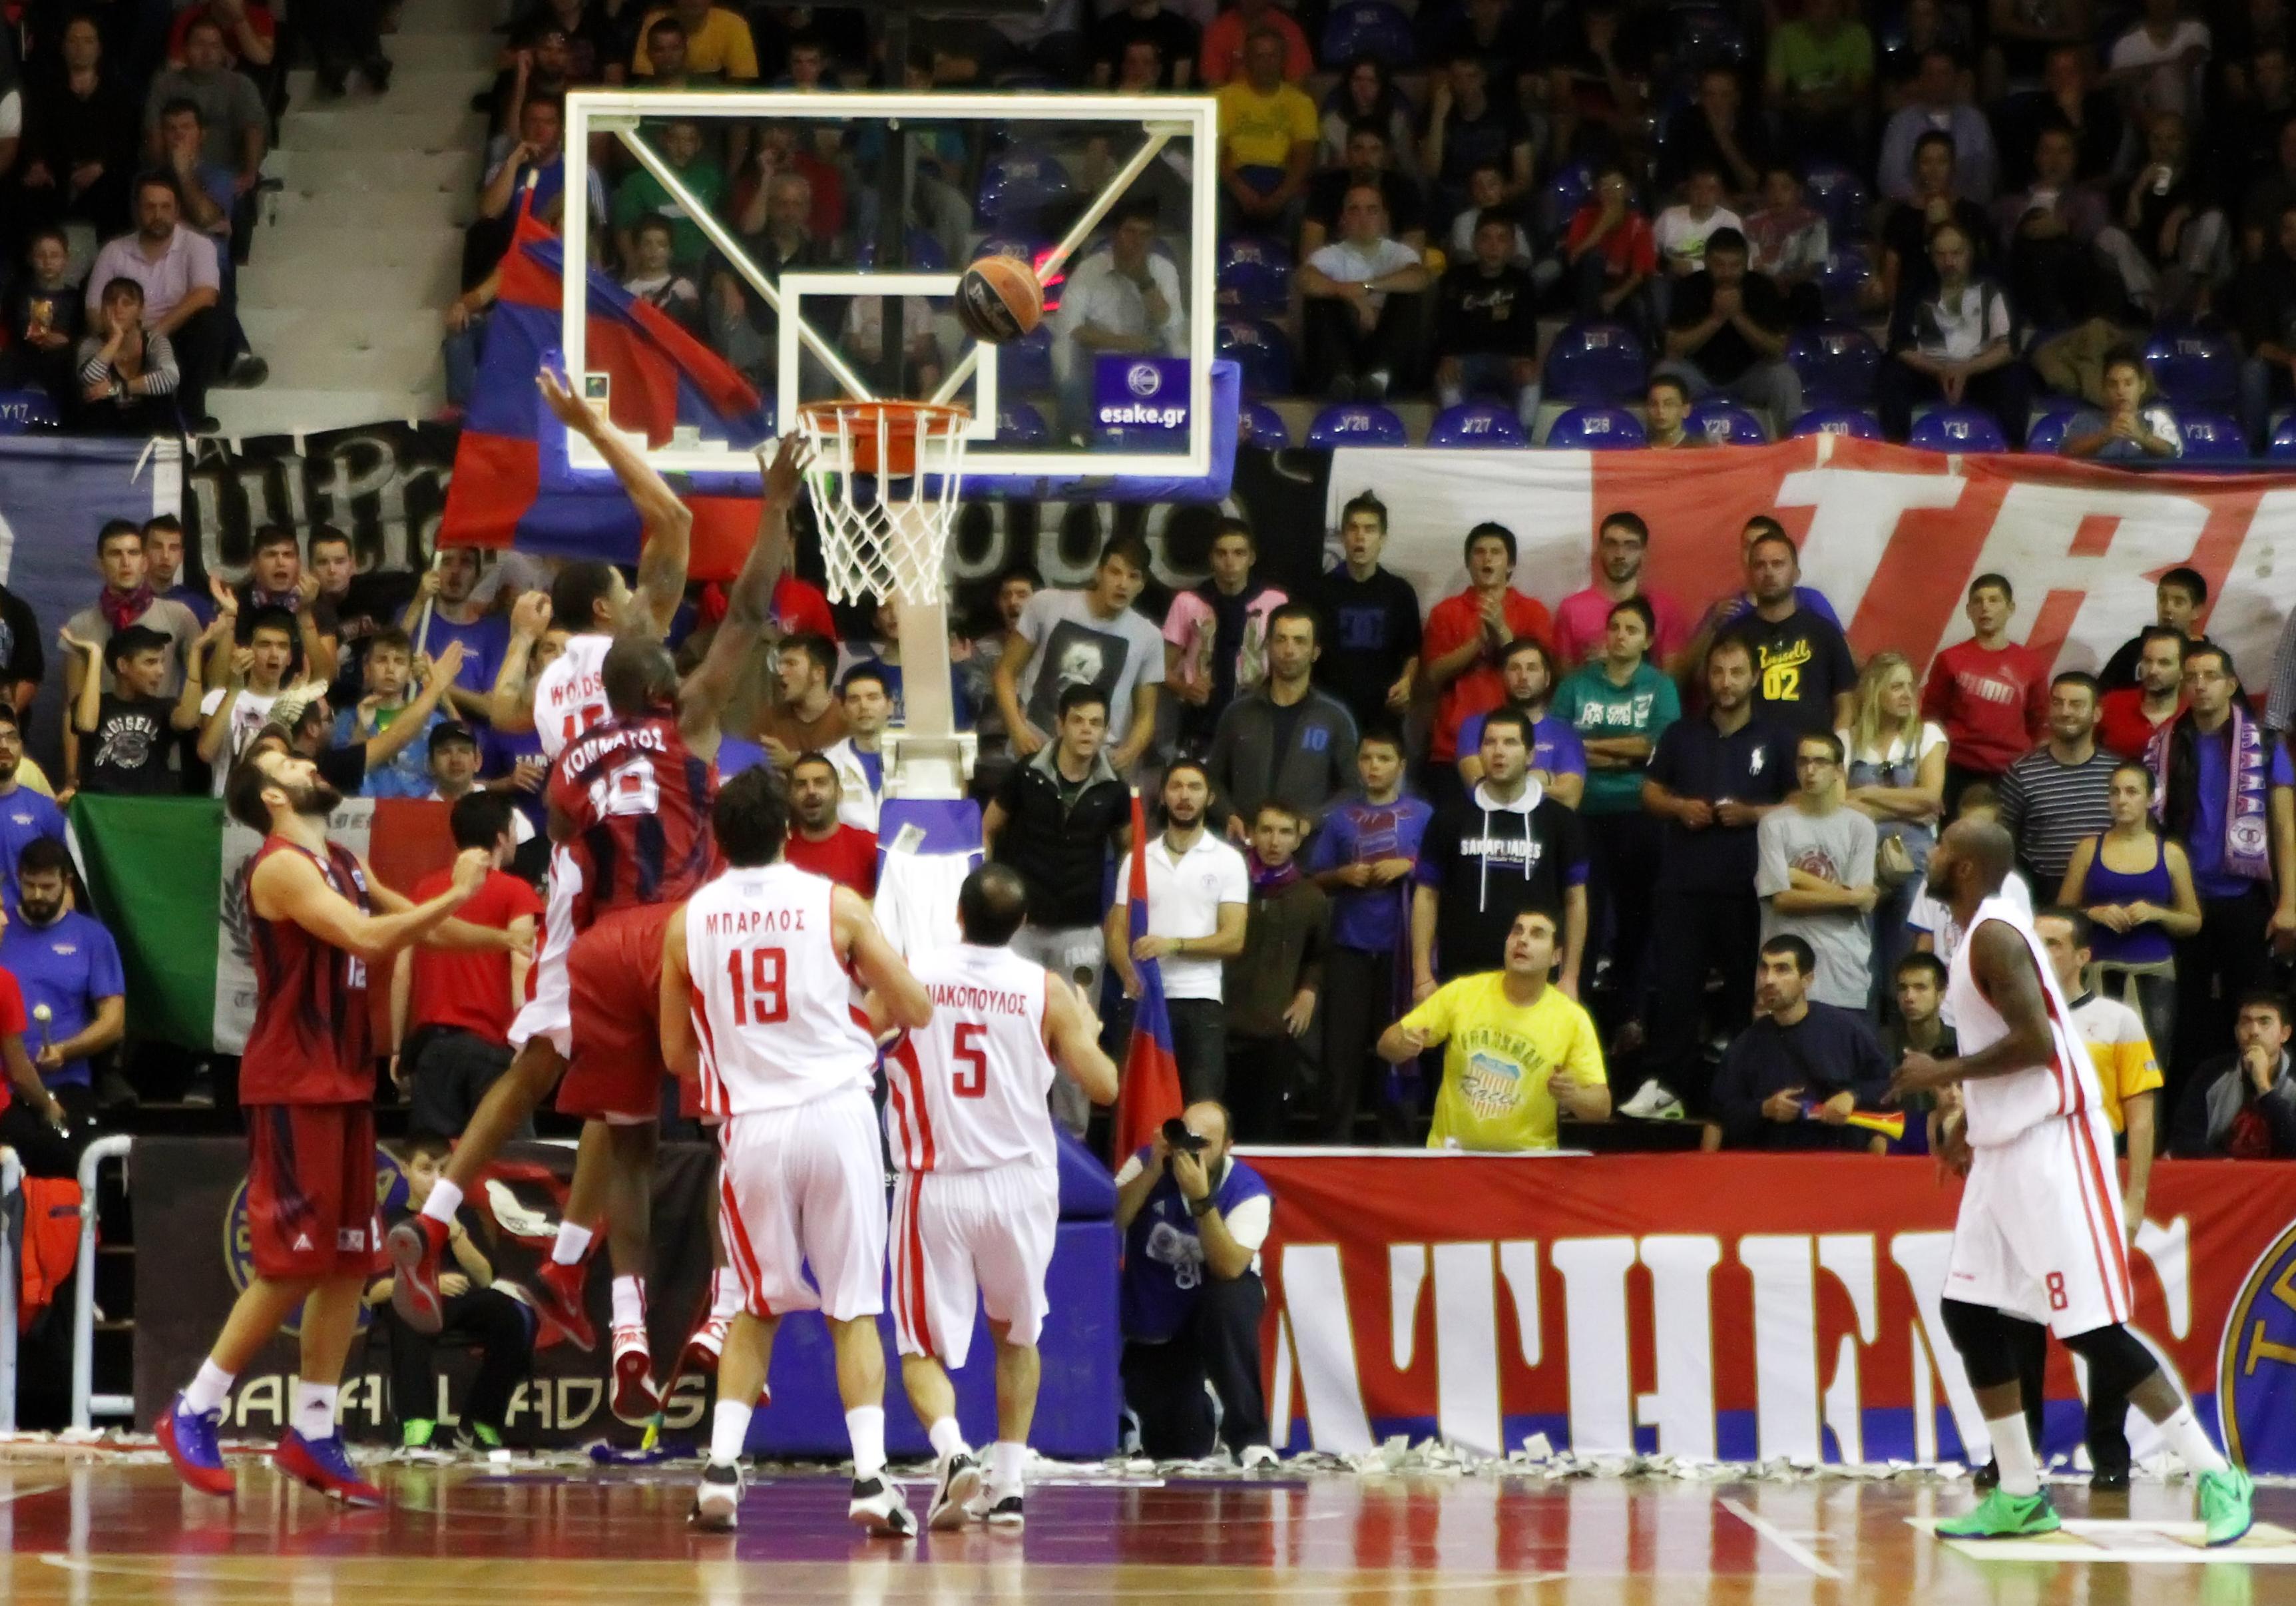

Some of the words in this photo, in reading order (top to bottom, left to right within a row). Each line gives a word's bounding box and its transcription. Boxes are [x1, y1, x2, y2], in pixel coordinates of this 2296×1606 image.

[1100, 403, 1186, 428] esake.gr
[1763, 668, 1800, 701] 02
[706, 909, 805, 936] ΜΠΑΡΛΟΣ
[727, 947, 789, 1026] 19
[953, 1023, 987, 1098] 5
[2045, 1271, 2068, 1311] 8
